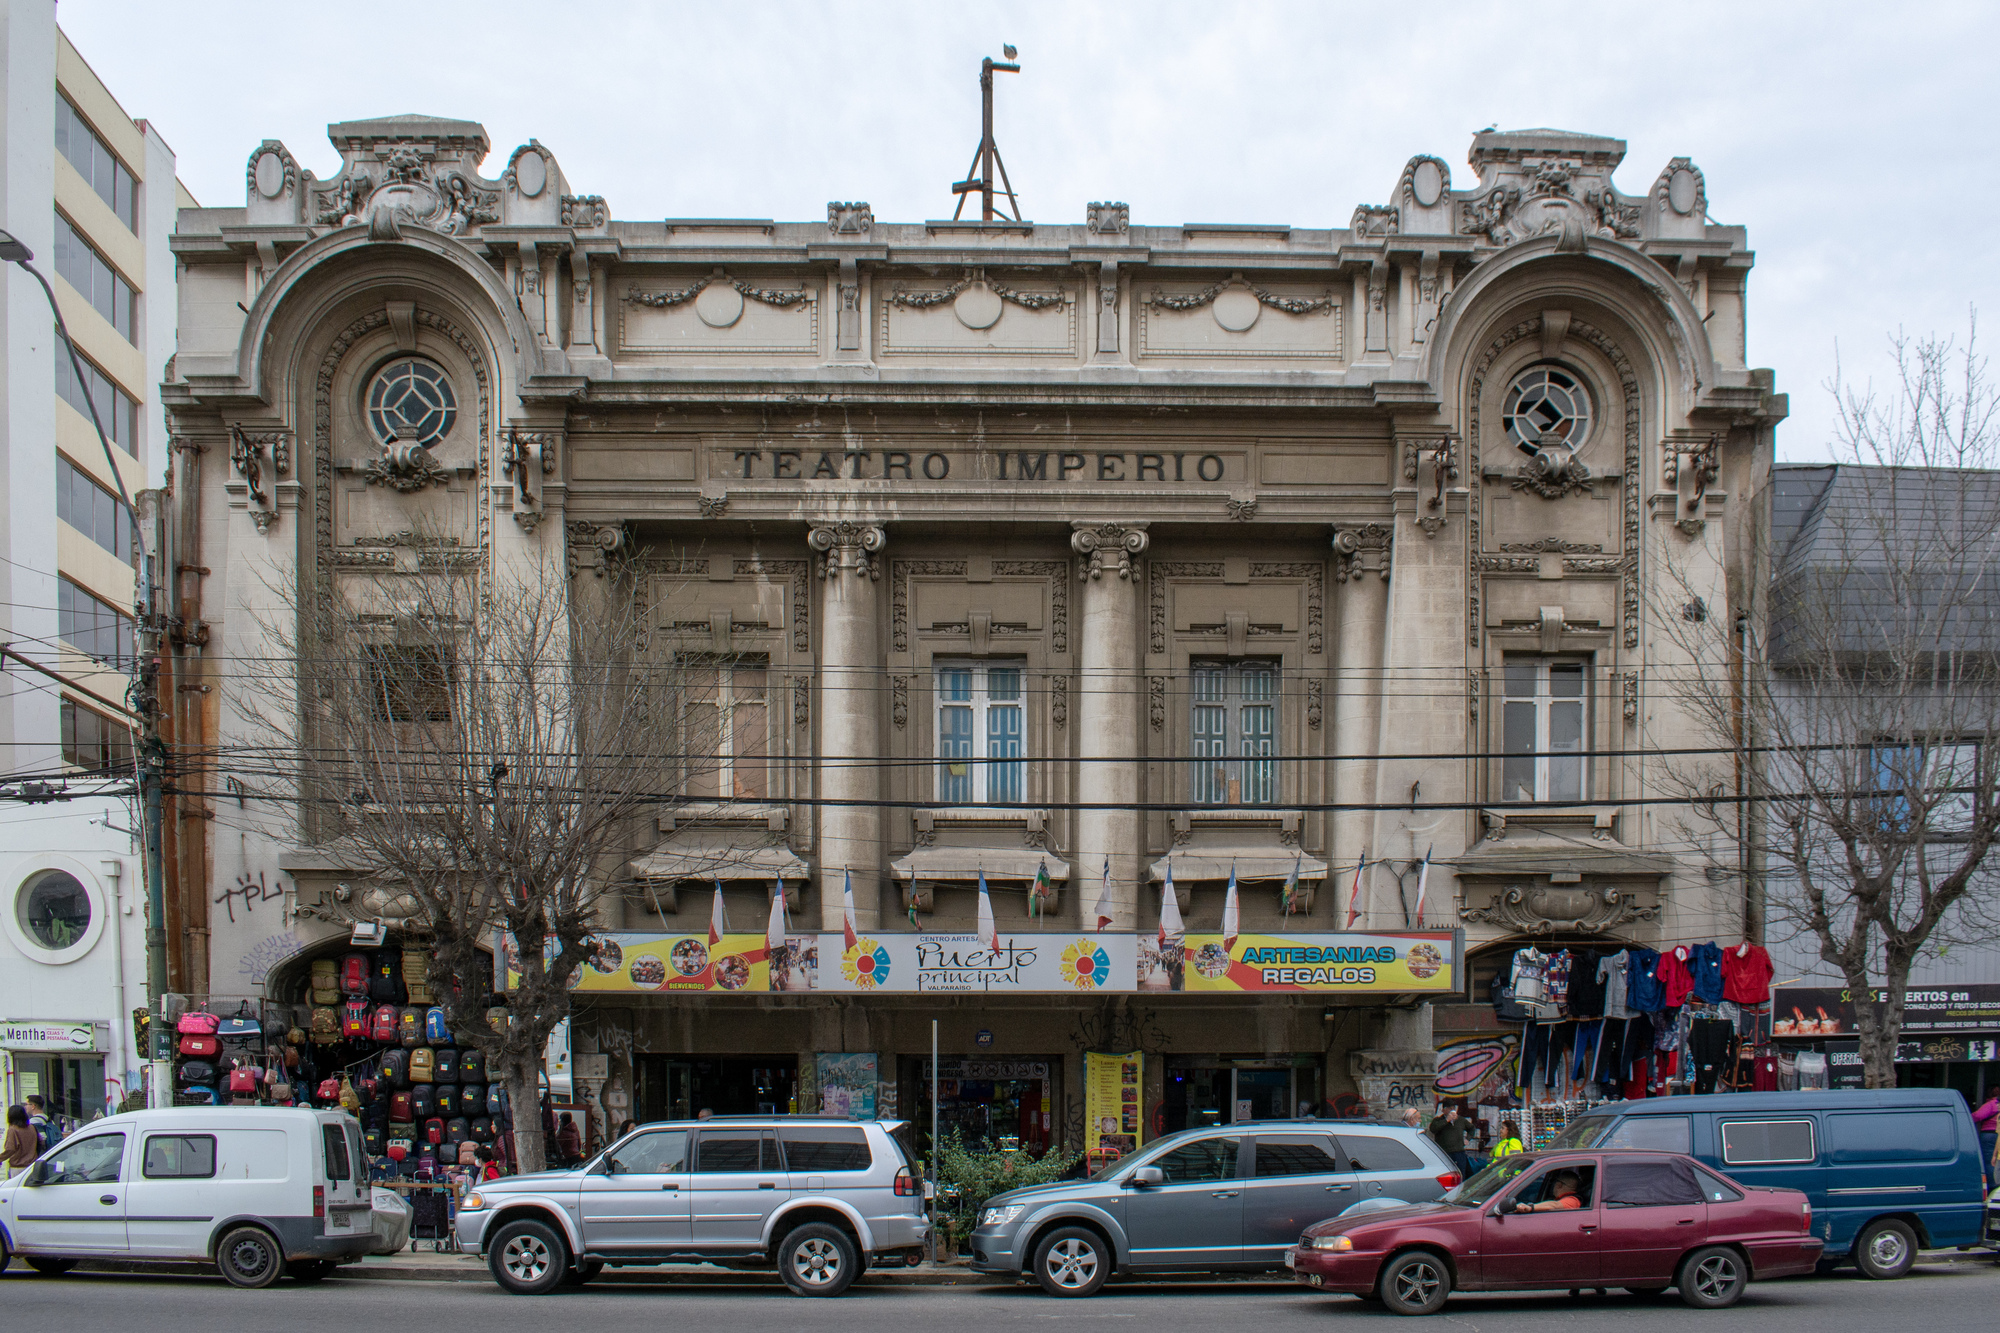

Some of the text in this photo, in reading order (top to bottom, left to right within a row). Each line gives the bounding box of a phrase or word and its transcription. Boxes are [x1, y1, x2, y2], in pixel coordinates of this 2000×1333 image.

[734, 450, 1224, 481] TEATRO IMPERIO
[916, 939, 1037, 970] Puerto
[1241, 946, 1396, 964] ARTESANIAS
[917, 966, 1019, 991] principal
[1262, 967, 1376, 985] REGALOS
[668, 982, 705, 991] BIENVENIDOS
[1951, 992, 1970, 1001] en
[7, 1028, 46, 1040] Mentha
[1831, 1052, 1865, 1066] OFERTA
